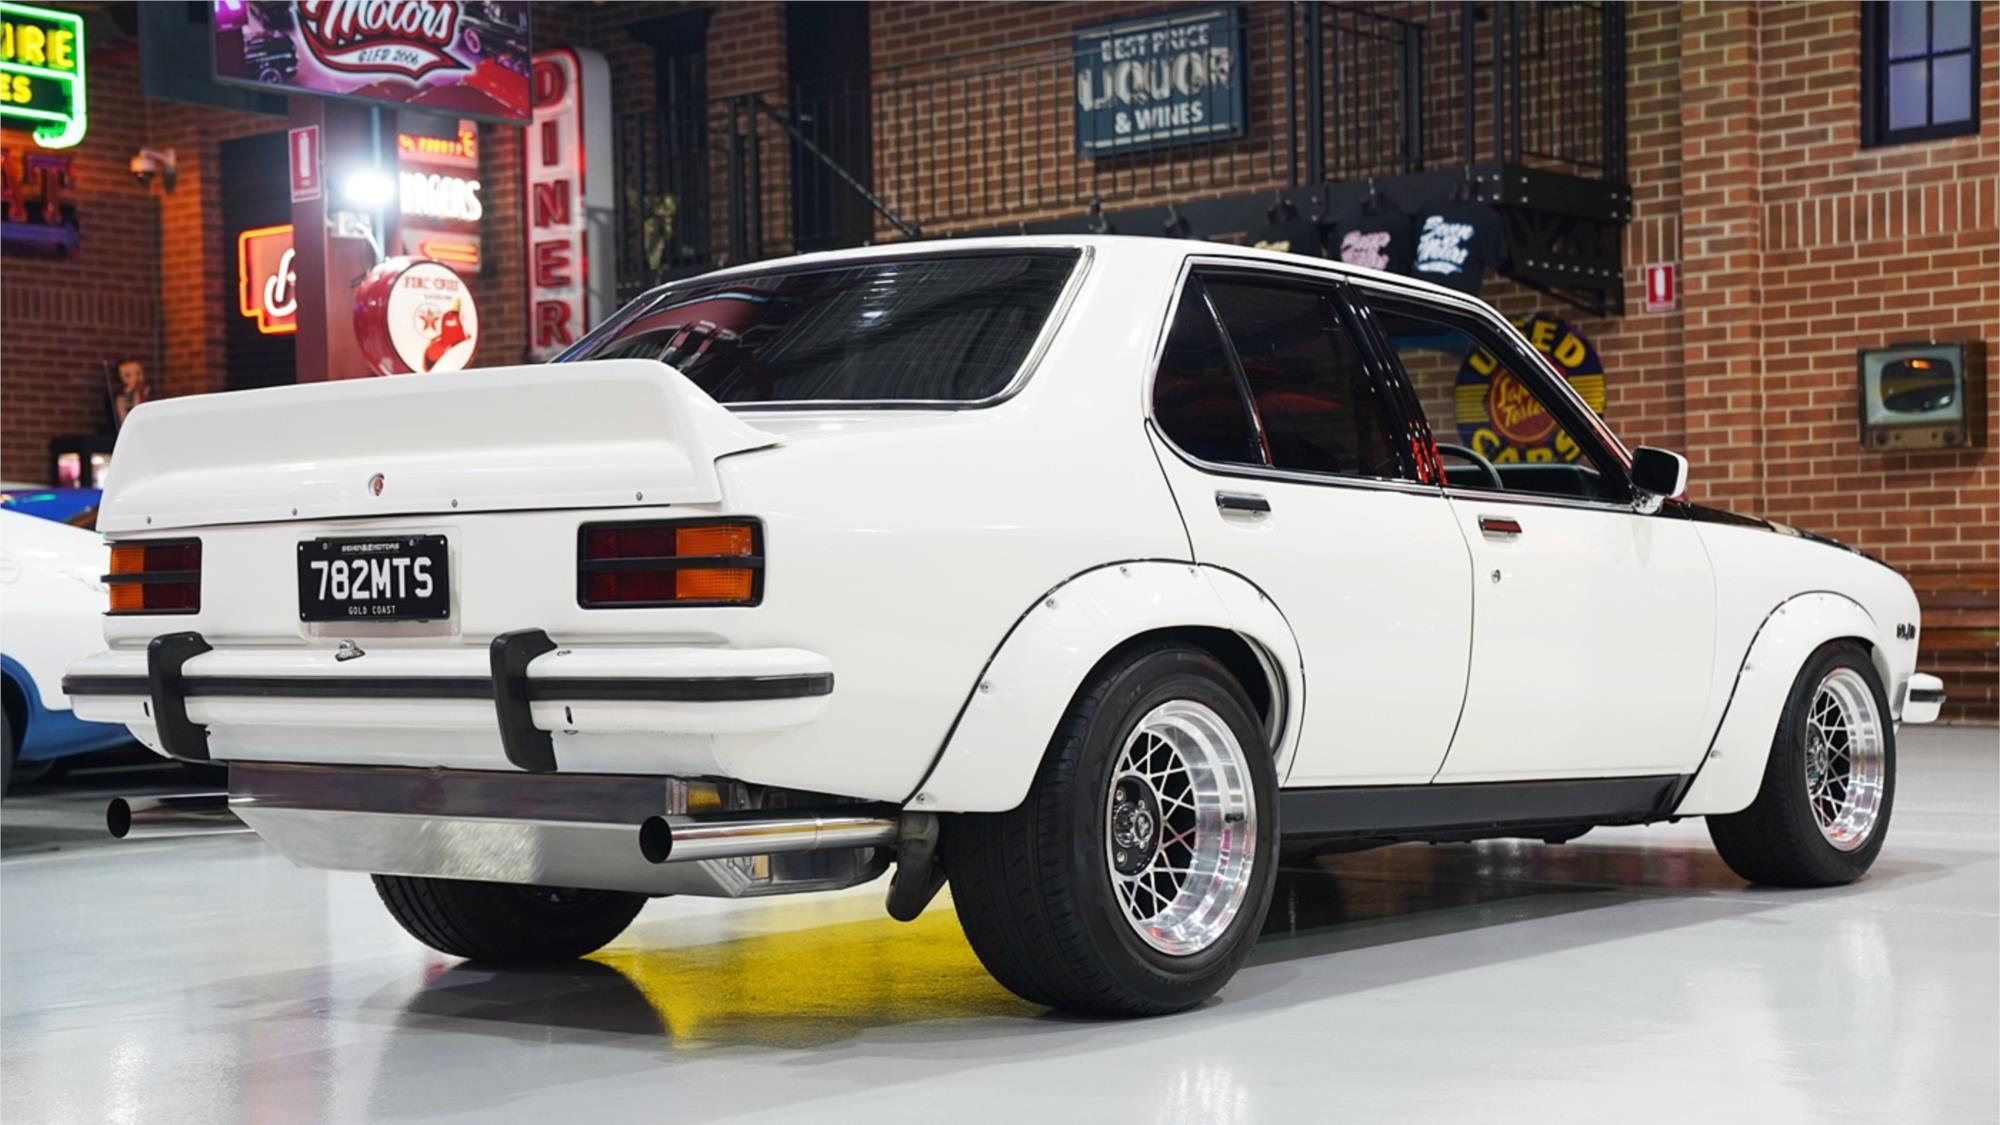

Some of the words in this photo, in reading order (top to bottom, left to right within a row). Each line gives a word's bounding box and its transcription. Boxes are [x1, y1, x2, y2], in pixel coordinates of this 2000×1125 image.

[1101, 34, 1149, 62] BEST
[1078, 47, 1229, 111] LIQUOR
[1115, 112, 1131, 134] &
[1134, 101, 1203, 131] WINES
[534, 60, 572, 348] DINER
[1469, 318, 1586, 376] UED
[310, 556, 433, 600] 782MTS
[348, 606, 368, 615] GOLD
[372, 605, 396, 615] COAST
